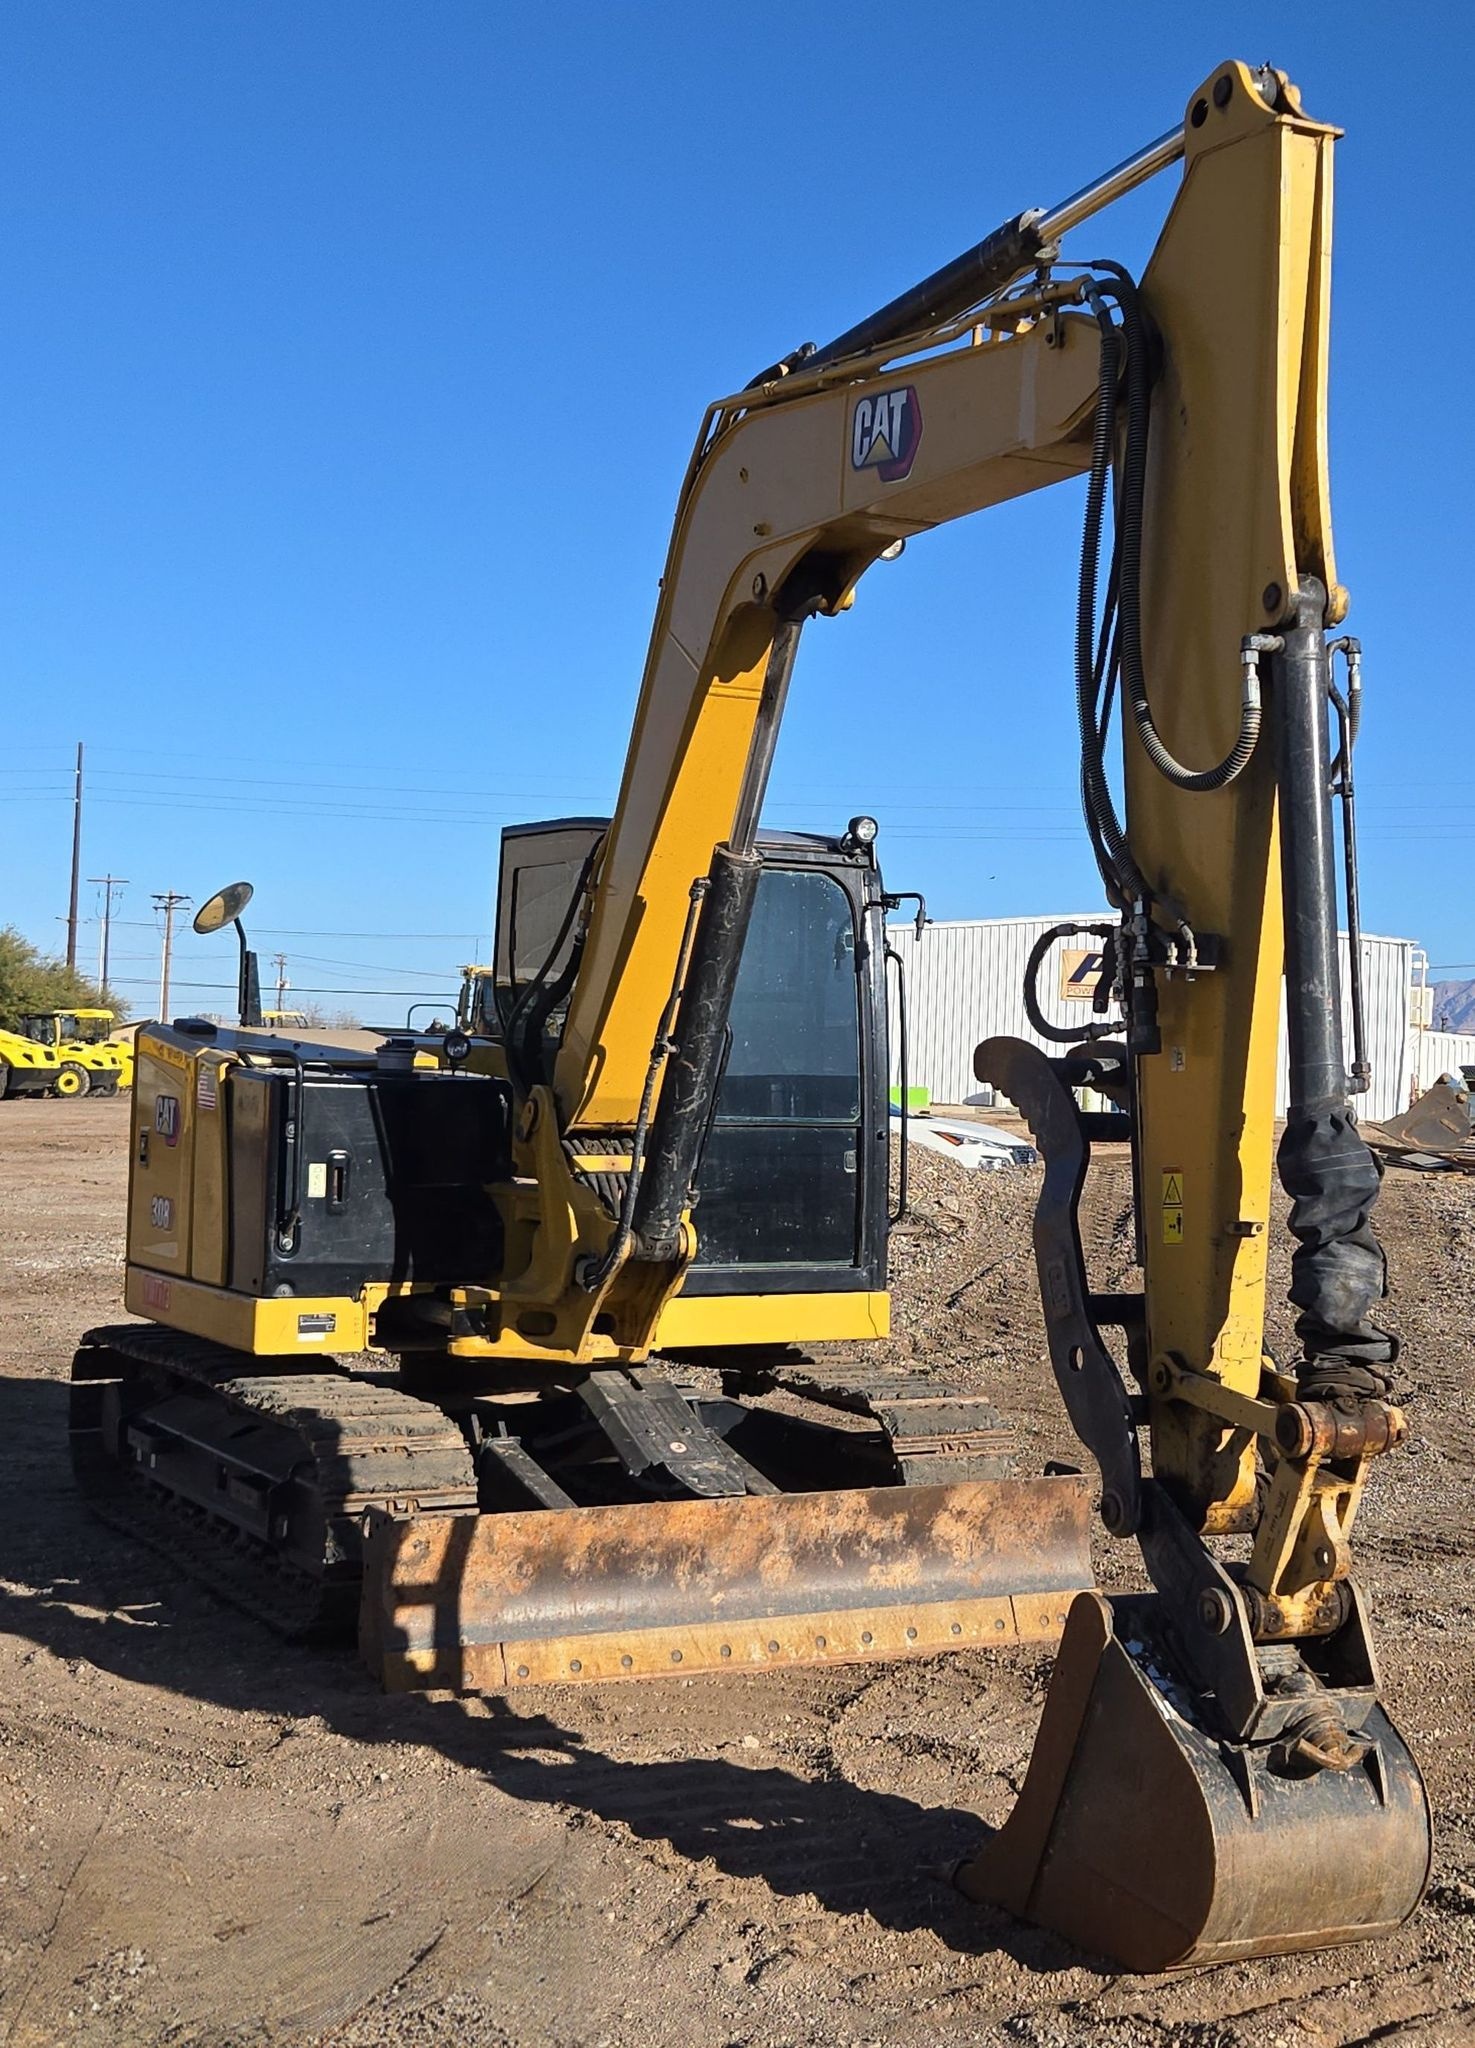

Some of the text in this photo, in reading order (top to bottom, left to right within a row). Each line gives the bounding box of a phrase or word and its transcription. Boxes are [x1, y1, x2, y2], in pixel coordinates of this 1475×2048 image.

[853, 388, 908, 467] CAT
[156, 1096, 177, 1134] CAT
[152, 1196, 170, 1229] 308
